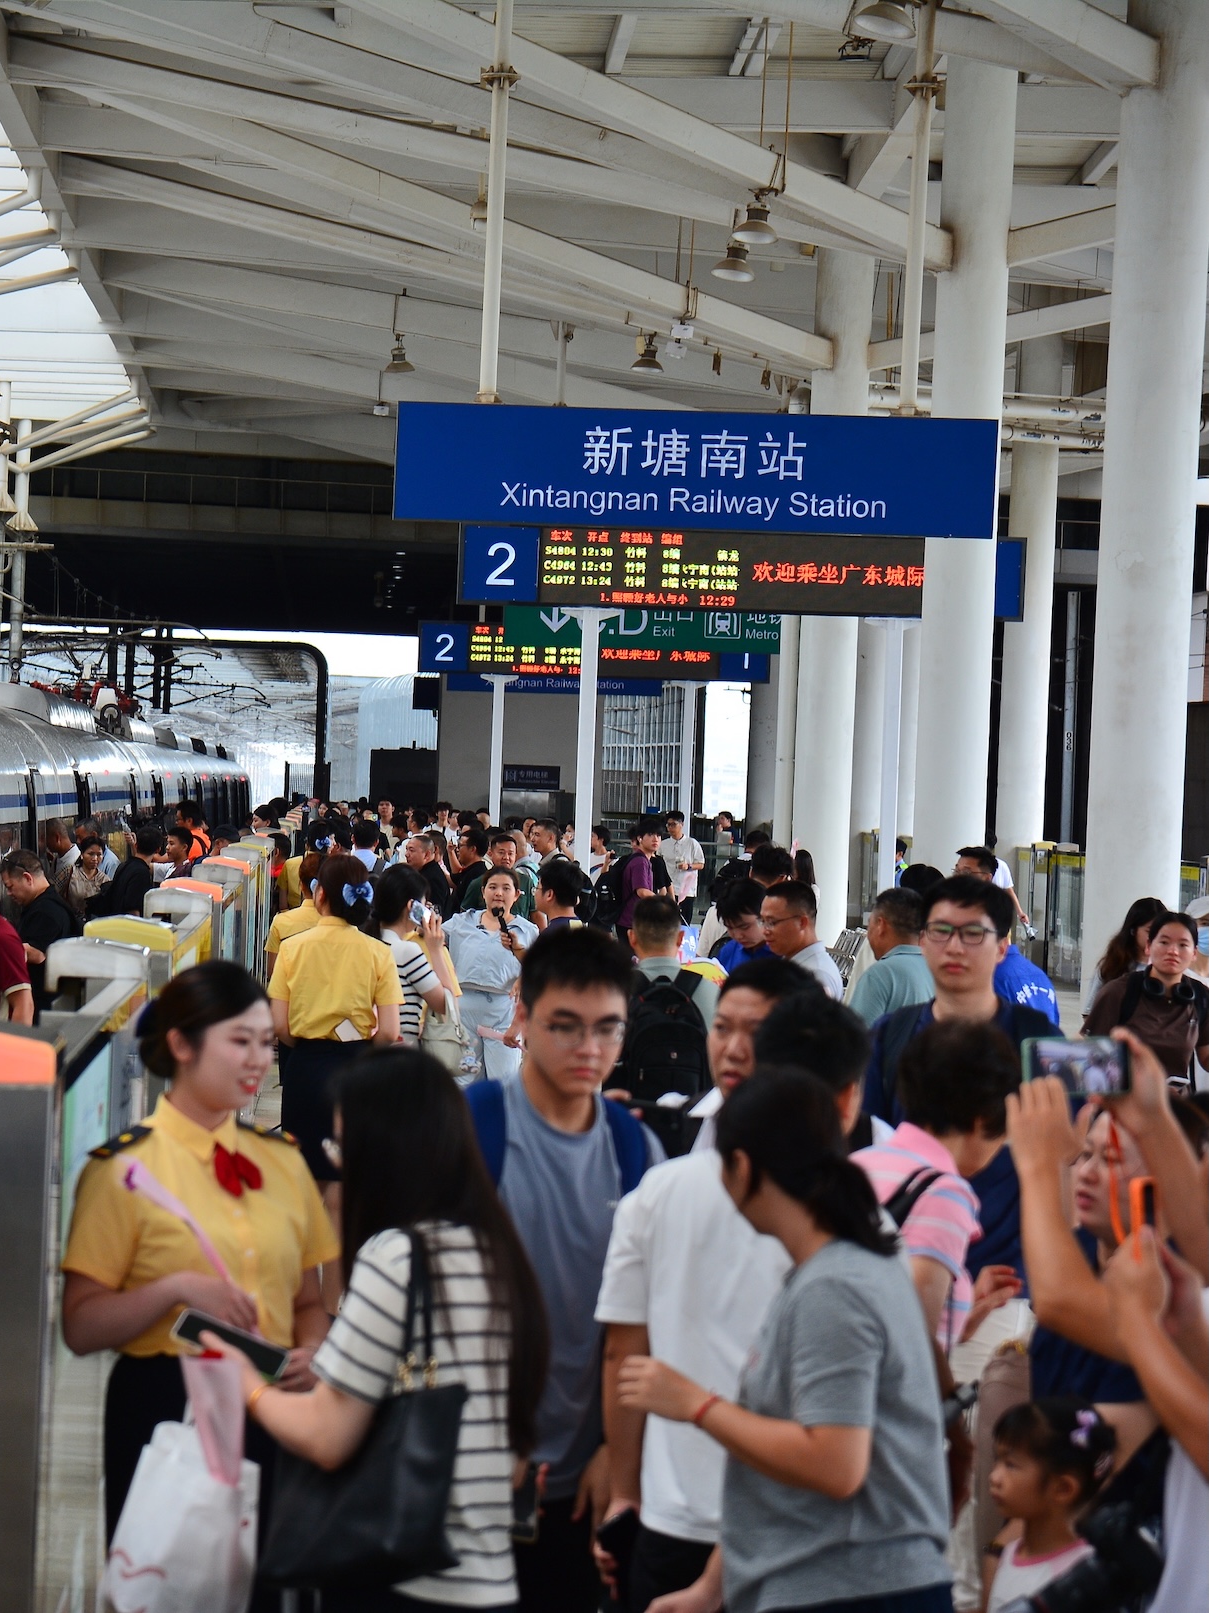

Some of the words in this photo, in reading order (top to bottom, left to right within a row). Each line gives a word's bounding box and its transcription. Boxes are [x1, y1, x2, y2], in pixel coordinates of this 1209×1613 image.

[582, 425, 807, 481] 新塘南站
[500, 481, 658, 515] Xintangnan
[669, 487, 779, 521] Railway
[789, 492, 887, 519] Station
[550, 530, 573, 542] 车次
[587, 531, 610, 543] 开点
[620, 532, 653, 544] 终到站
[545, 546, 577, 556] S4804
[581, 547, 614, 557] 12:30
[485, 542, 516, 586] 2
[543, 575, 576, 585] C4972
[581, 576, 612, 586] 13:24
[752, 560, 925, 587] 欢迎乘坐广东城际
[699, 595, 737, 607] 12:29
[653, 626, 676, 637] Exit
[745, 629, 779, 640] Metro
[435, 634, 454, 661] 2
